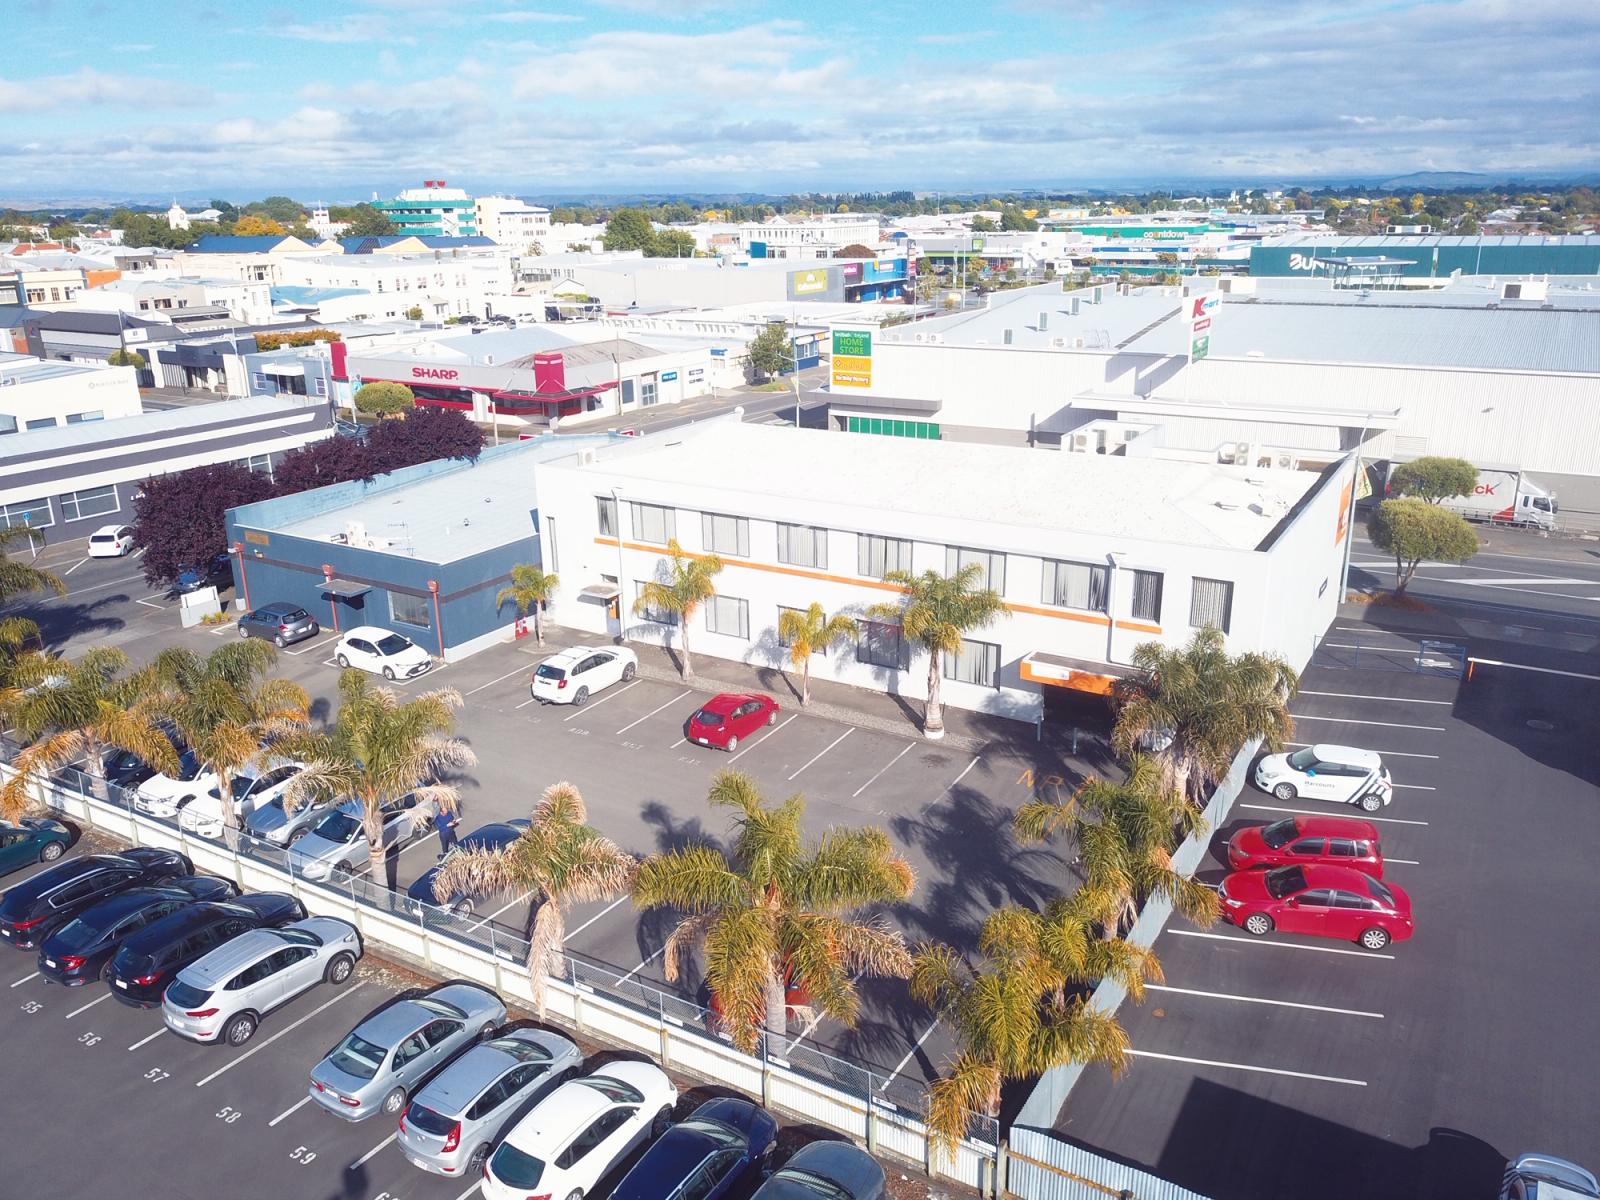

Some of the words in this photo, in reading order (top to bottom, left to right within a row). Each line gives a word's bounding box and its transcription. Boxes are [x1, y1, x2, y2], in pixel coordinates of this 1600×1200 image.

[1192, 296, 1219, 318] Kmart
[840, 338, 864, 346] HOME
[840, 346, 864, 355] STORE
[412, 367, 458, 381] SHARP
[1304, 780, 1336, 789] Harcourts
[20, 1001, 43, 1015] 55
[77, 1031, 103, 1047] 56
[143, 1067, 171, 1083] 57
[215, 1106, 242, 1124] 58
[288, 1145, 318, 1166] 59
